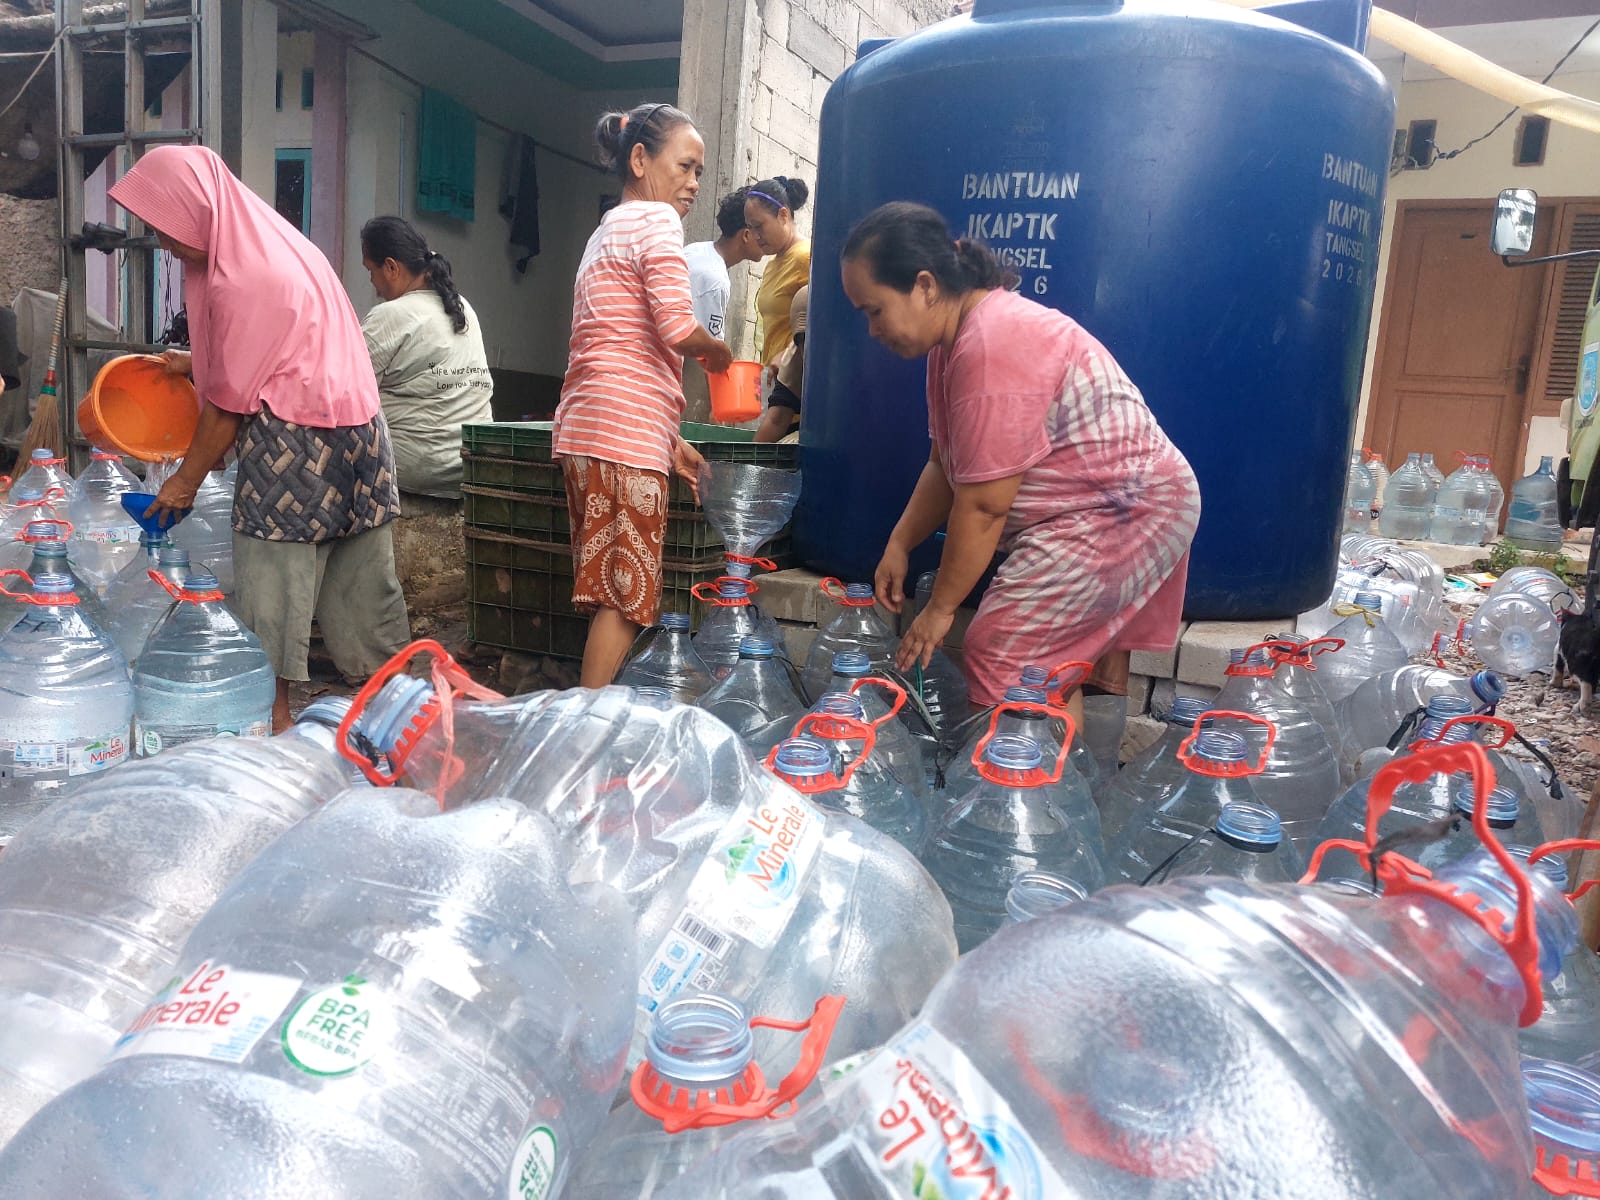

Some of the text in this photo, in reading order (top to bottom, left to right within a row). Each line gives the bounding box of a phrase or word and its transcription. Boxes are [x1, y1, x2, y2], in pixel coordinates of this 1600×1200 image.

[962, 172, 1080, 200] BANTUAN
[1322, 153, 1378, 198] BANTUAN
[968, 212, 1058, 240] IKAPTK
[1327, 199, 1371, 235] IKAPTK
[990, 247, 1052, 269] NGSEL
[1326, 232, 1364, 262] TANGSEL
[110, 737, 121, 749] Le
[748, 808, 779, 836] Le
[747, 804, 806, 892] Minerale
[180, 963, 224, 994] Le
[318, 998, 372, 1029] BPA
[306, 1015, 366, 1047] FREE
[879, 1100, 926, 1162] Le
